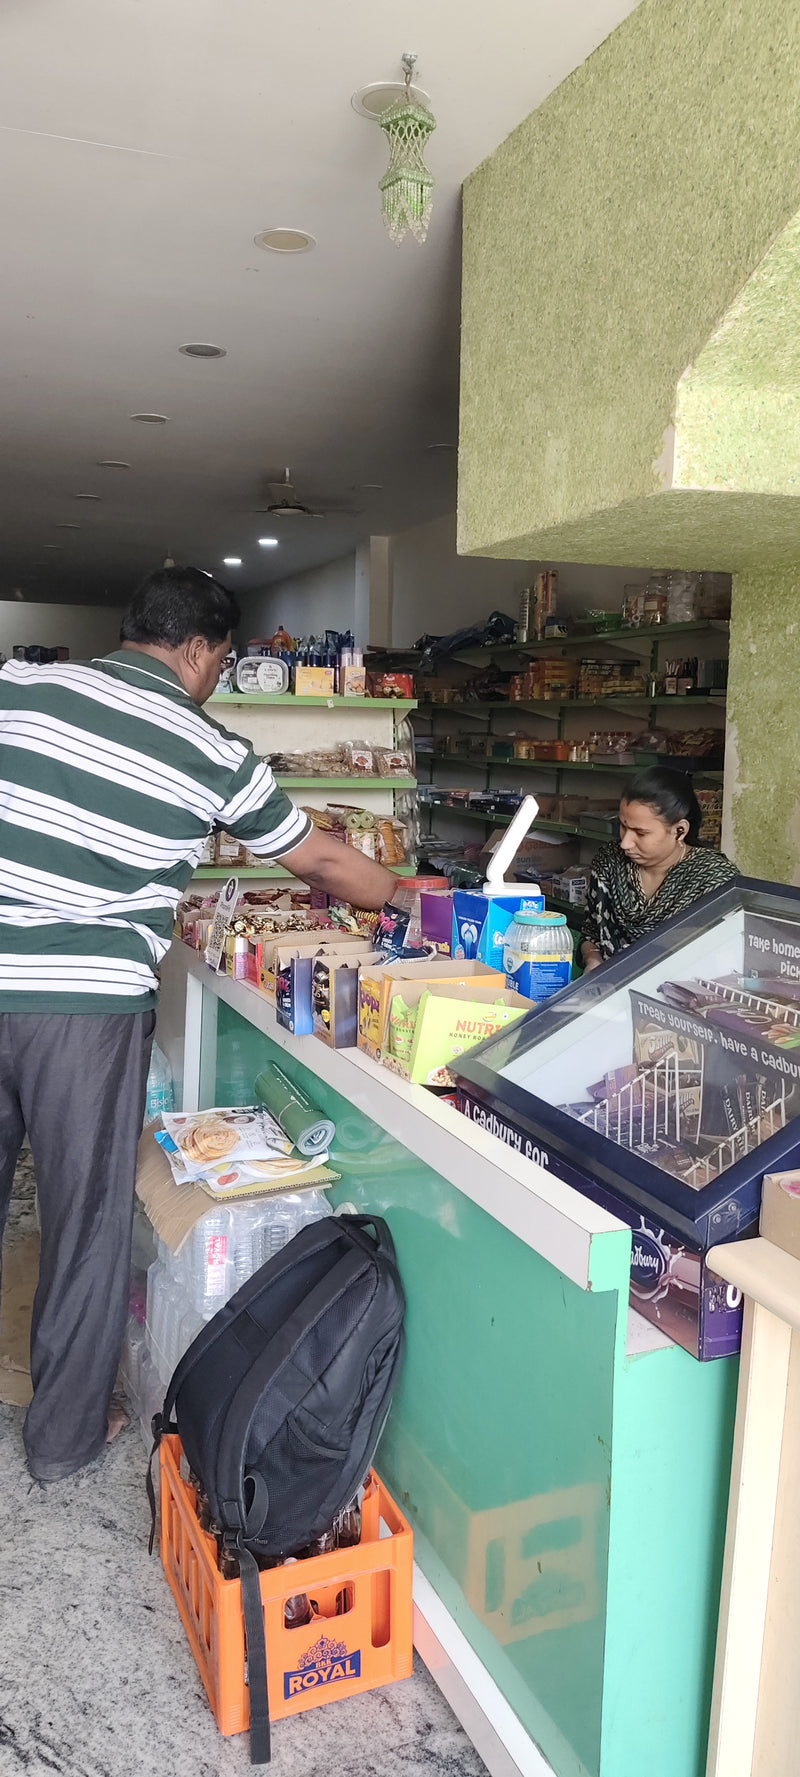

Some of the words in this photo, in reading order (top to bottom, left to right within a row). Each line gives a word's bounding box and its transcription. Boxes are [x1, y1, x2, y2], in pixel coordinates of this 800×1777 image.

[749, 935, 770, 953] Take
[772, 938, 800, 958] home
[638, 1001, 666, 1023] Treat
[720, 1032, 748, 1056] have
[751, 1047, 759, 1062] a
[464, 1099, 471, 1117] A
[725, 1098, 738, 1131] DAIRY
[631, 1245, 659, 1274] adbury
[289, 1659, 356, 1695] ROYAL
